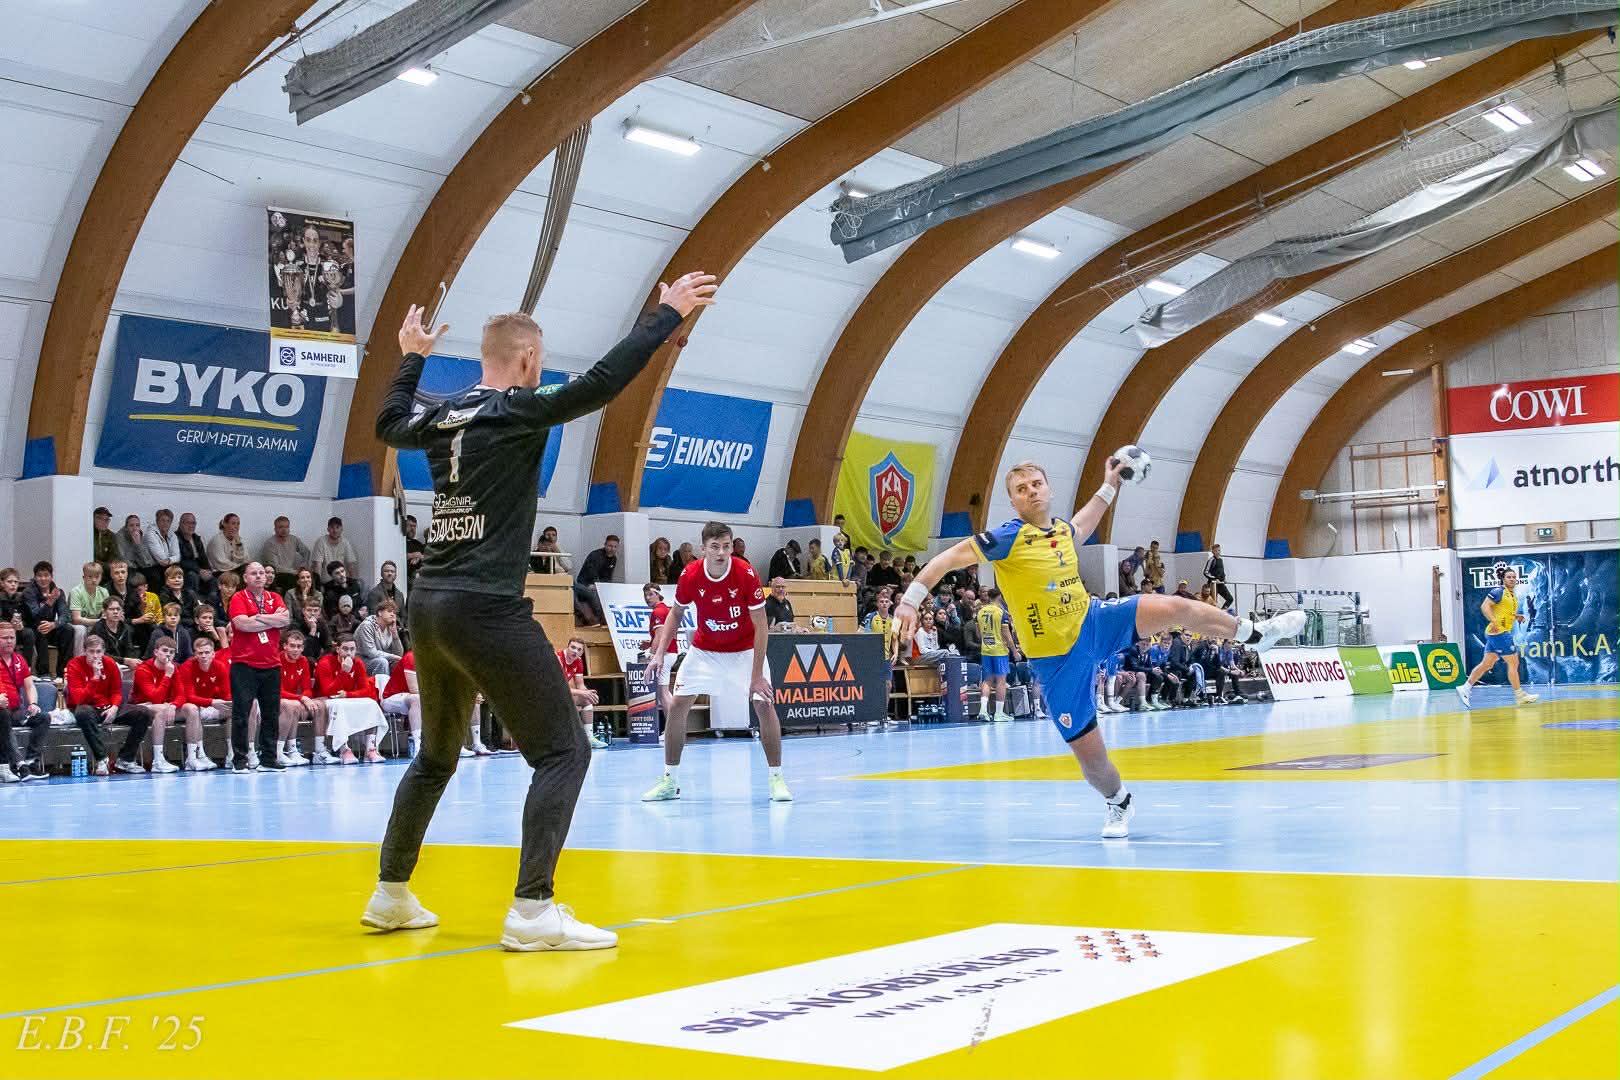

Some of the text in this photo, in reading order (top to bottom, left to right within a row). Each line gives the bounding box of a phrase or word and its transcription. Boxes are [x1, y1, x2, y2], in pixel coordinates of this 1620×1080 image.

[301, 351, 346, 364] SAMHERJI
[133, 357, 305, 417] BYKO
[1489, 385, 1588, 423] COWI
[176, 429, 219, 445] GERUM
[256, 436, 299, 452] SAMAN
[673, 436, 754, 470] EIMSKIP
[1513, 456, 1620, 488] atnorth
[729, 605, 741, 619] 18
[1265, 660, 1345, 684] NORÐURTORG
[775, 686, 864, 705] MALBIKUN
[786, 705, 855, 719] AKUREYRAR
[854, 967, 1063, 1019] www.sba.is
